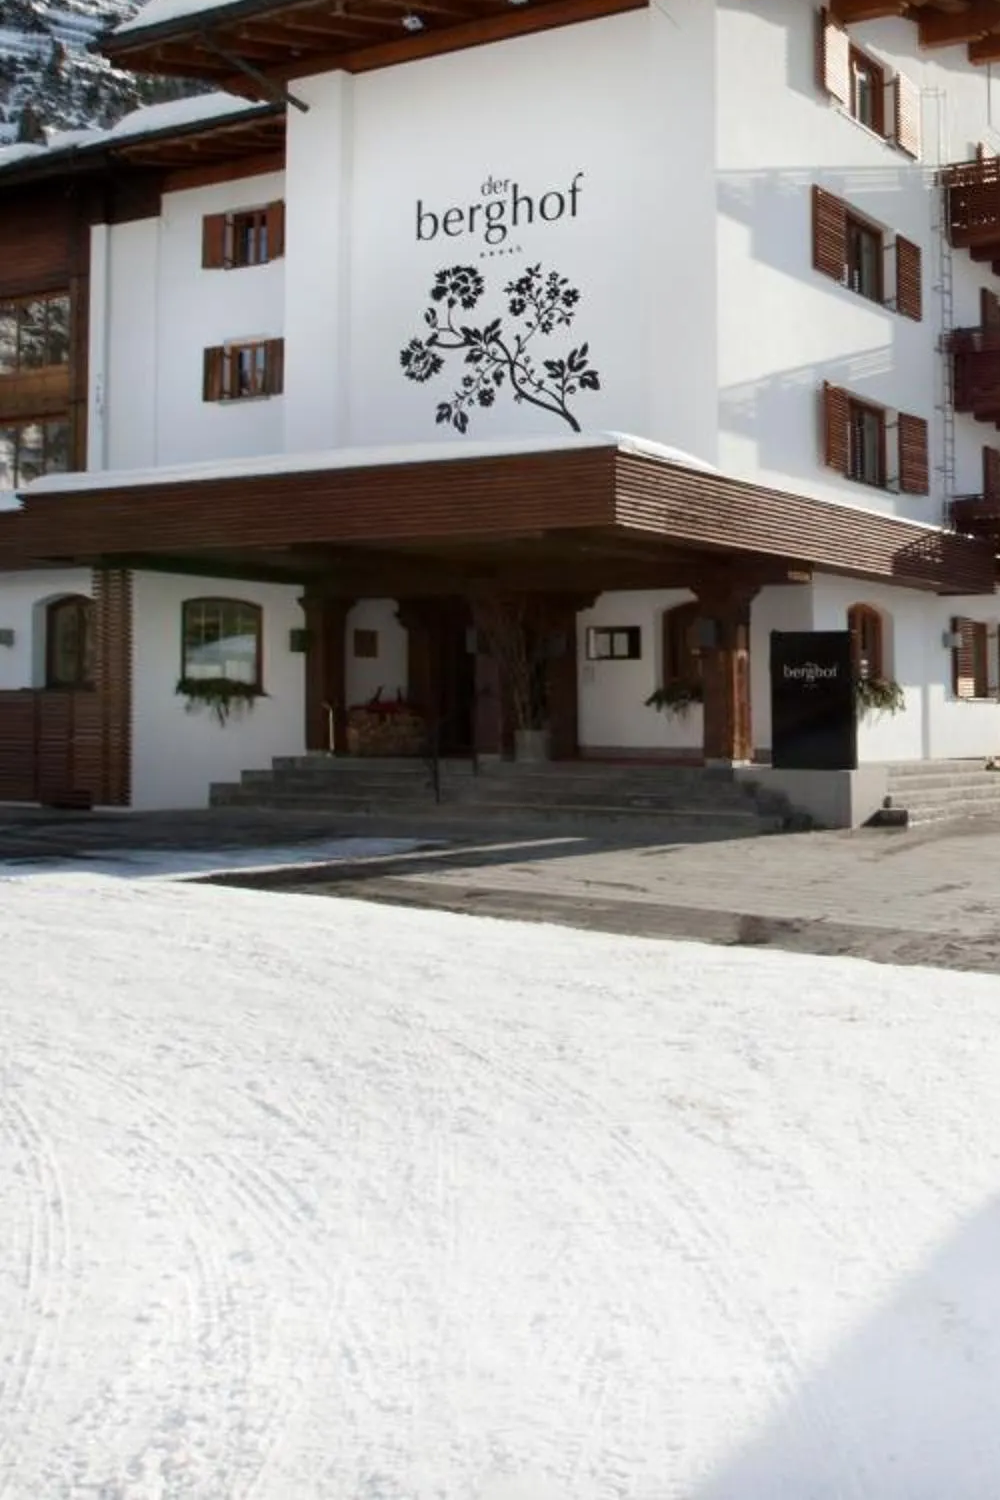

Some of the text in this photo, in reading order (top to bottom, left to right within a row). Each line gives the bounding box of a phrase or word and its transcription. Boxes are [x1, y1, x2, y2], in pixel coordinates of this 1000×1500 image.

[481, 175, 511, 197] der
[415, 171, 584, 245] berghof
[783, 662, 838, 682] berghof
